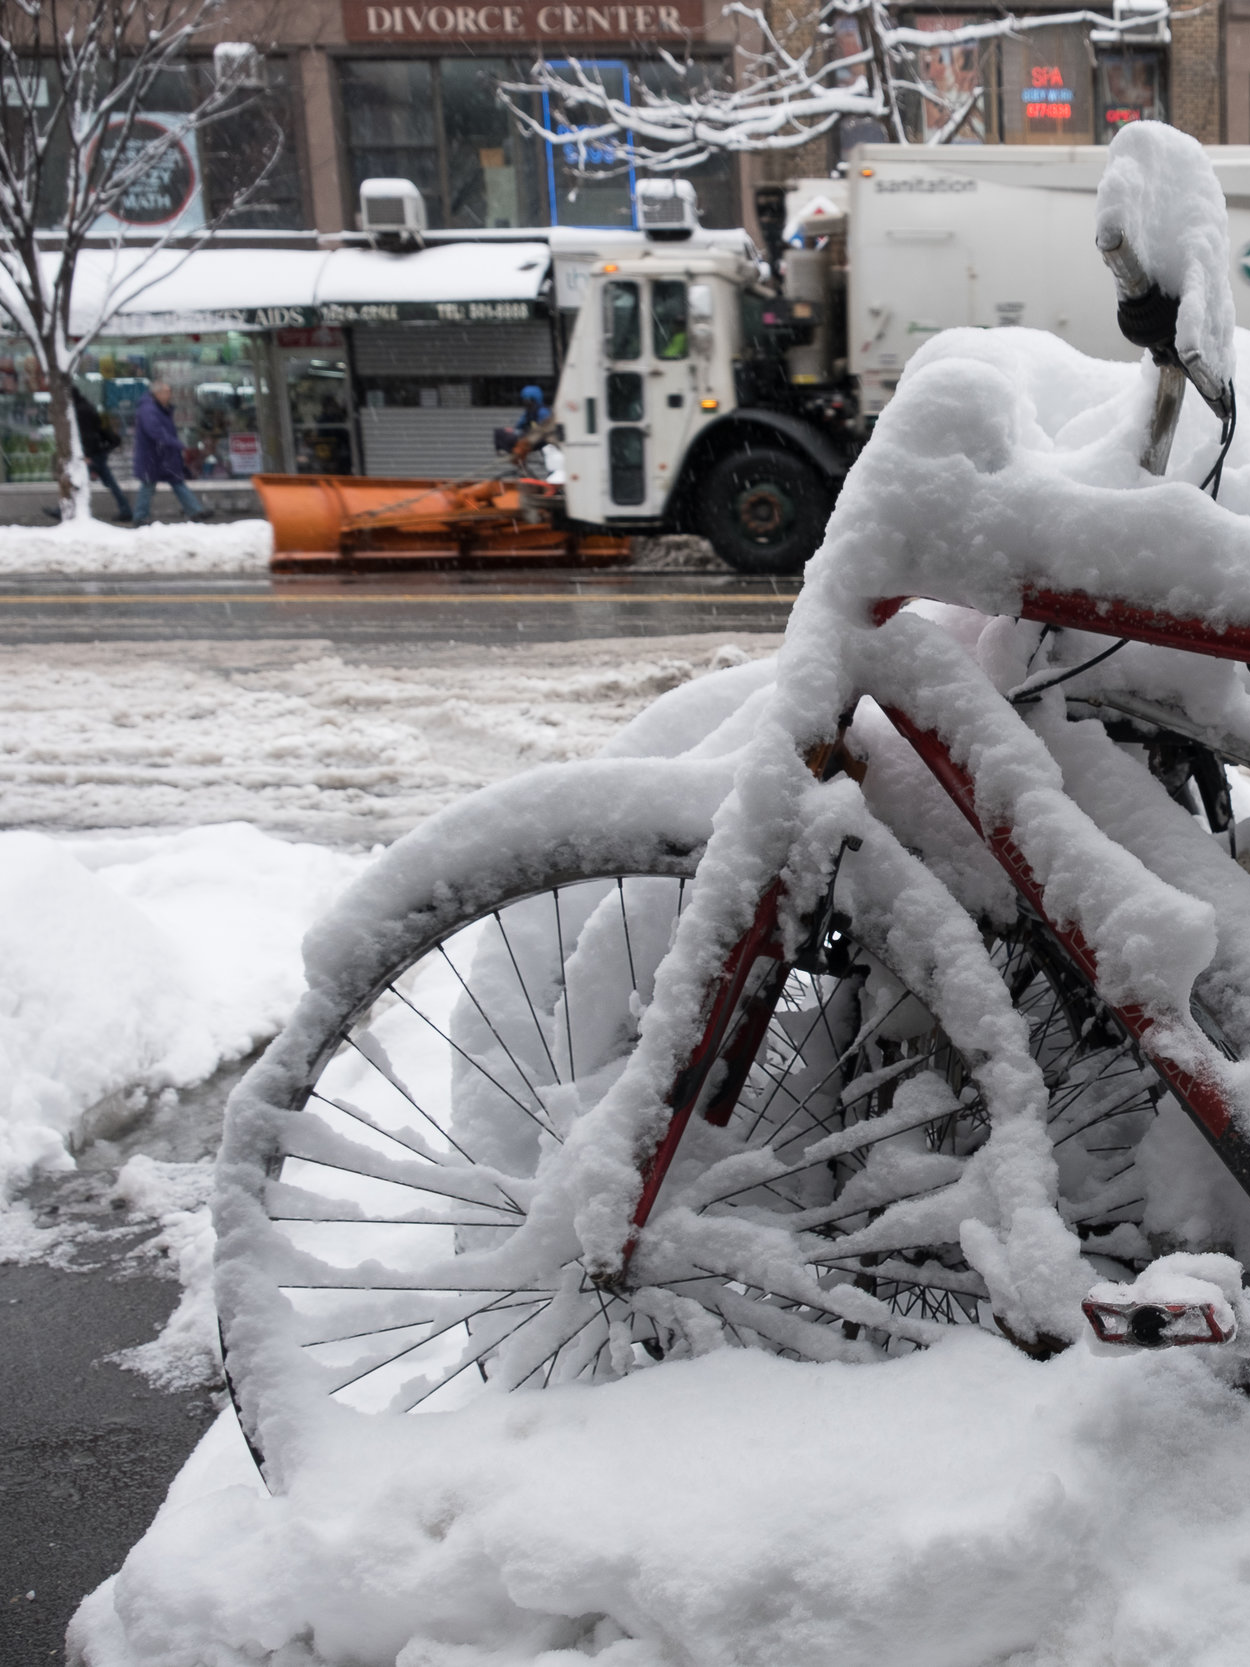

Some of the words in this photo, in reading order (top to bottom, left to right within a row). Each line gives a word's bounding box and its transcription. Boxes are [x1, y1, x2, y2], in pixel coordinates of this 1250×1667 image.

[366, 6, 525, 33] DIVORCE
[536, 5, 682, 33] CENTER
[1031, 66, 1063, 87] SPA
[875, 177, 978, 193] sanitation
[123, 193, 171, 210] MATH
[255, 307, 305, 328] AIDS
